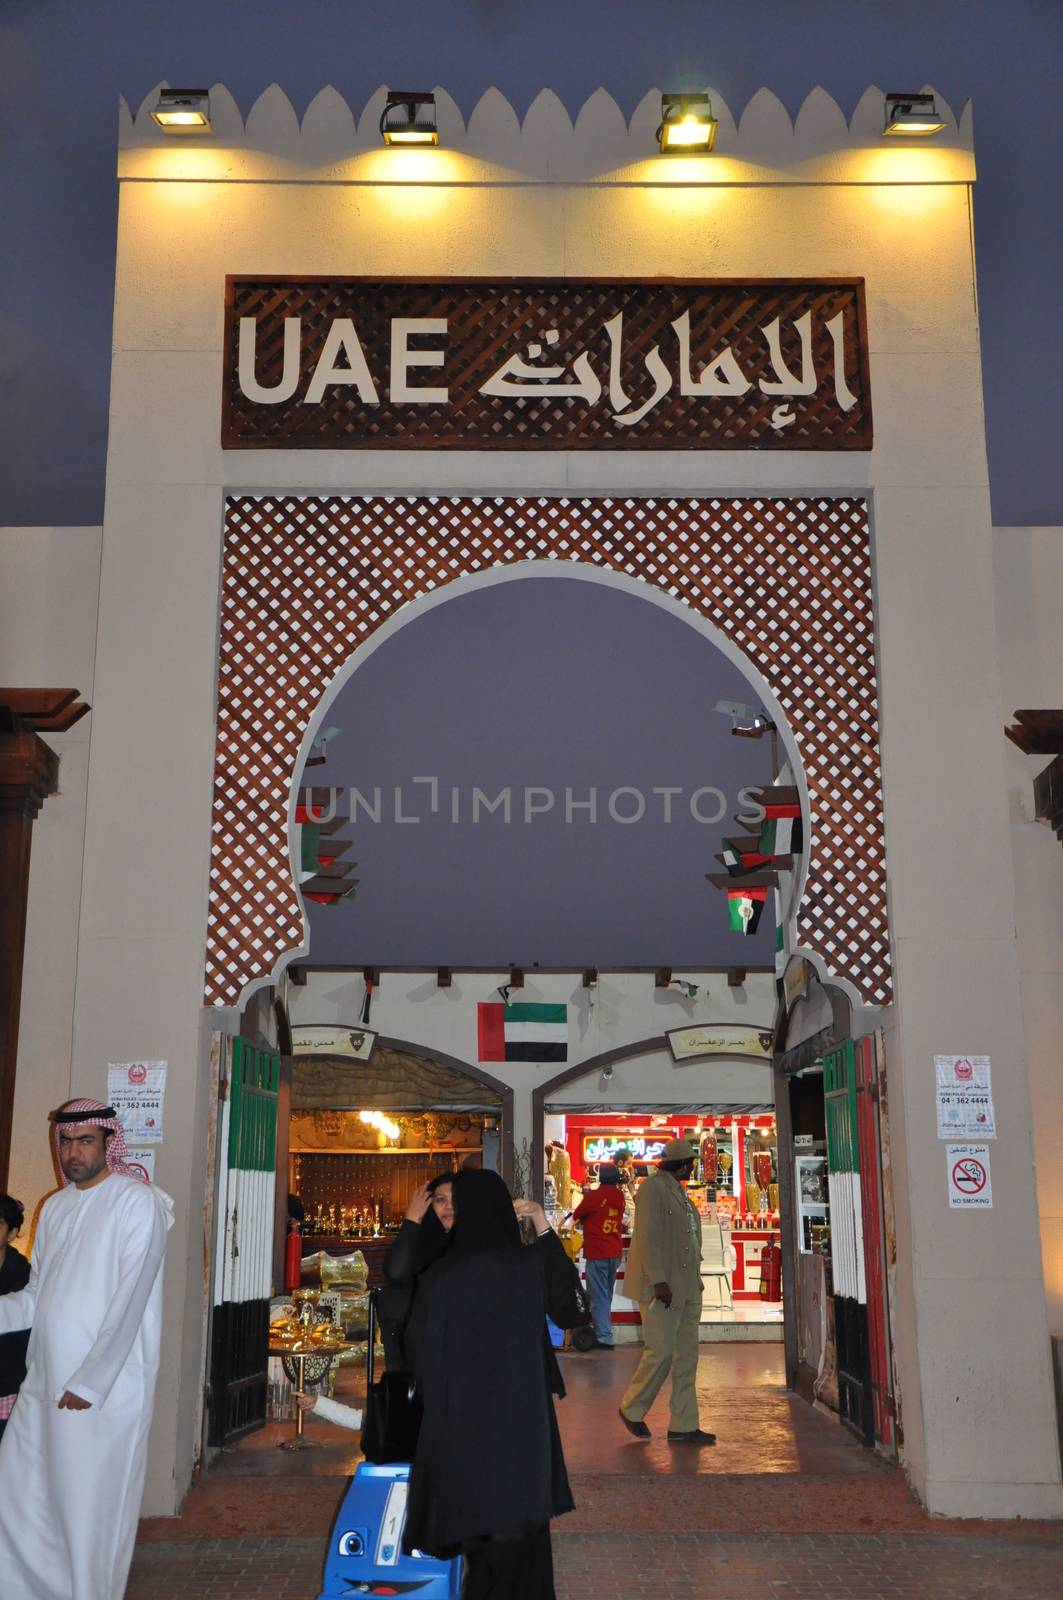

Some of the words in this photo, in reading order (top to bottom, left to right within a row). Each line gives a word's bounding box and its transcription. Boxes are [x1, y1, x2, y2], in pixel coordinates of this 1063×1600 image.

[237, 316, 449, 405] UAE
[478, 309, 859, 430] الإمارات
[642, 1142, 666, 1161] حر
